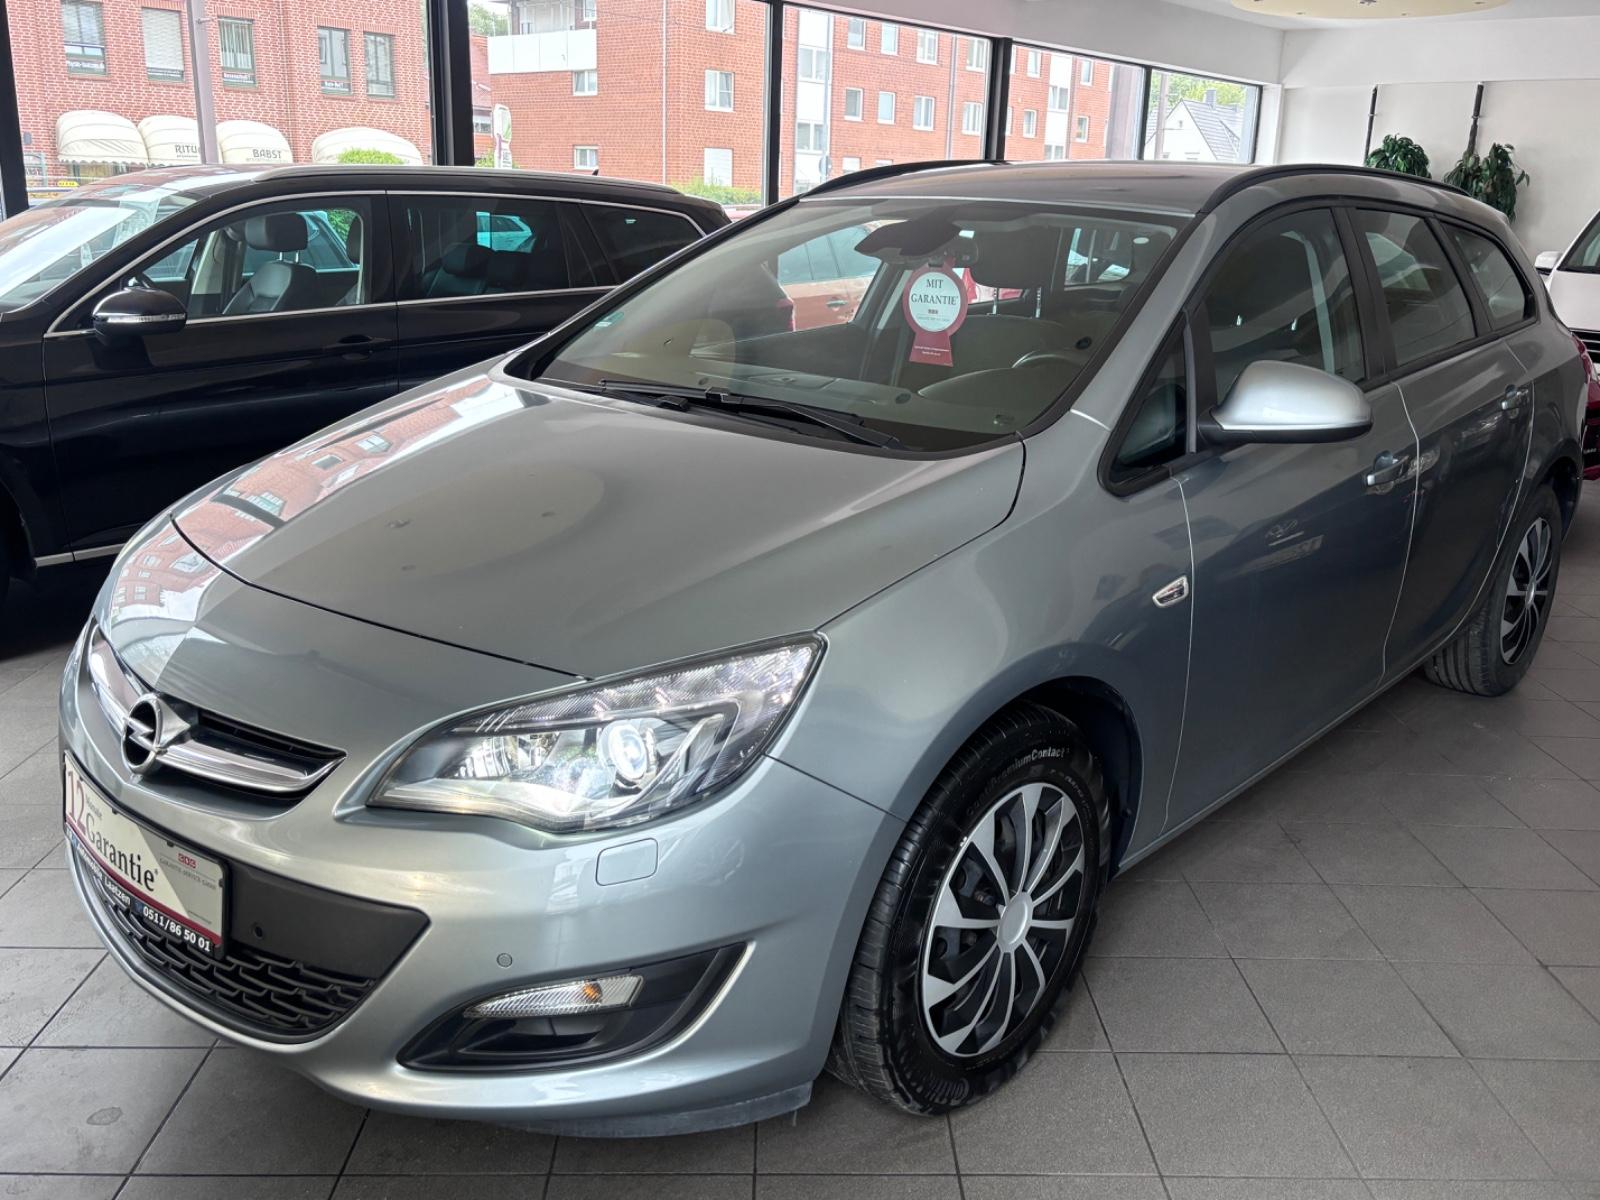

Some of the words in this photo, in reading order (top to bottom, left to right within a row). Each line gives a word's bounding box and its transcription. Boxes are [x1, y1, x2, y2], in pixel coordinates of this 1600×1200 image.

[175, 144, 200, 154] RITU
[252, 148, 281, 159] BABST
[926, 278, 944, 289] MIT
[67, 770, 87, 836] 12
[143, 906, 182, 936] 0511/86
[183, 929, 197, 944] 50
[197, 936, 211, 952] 01
